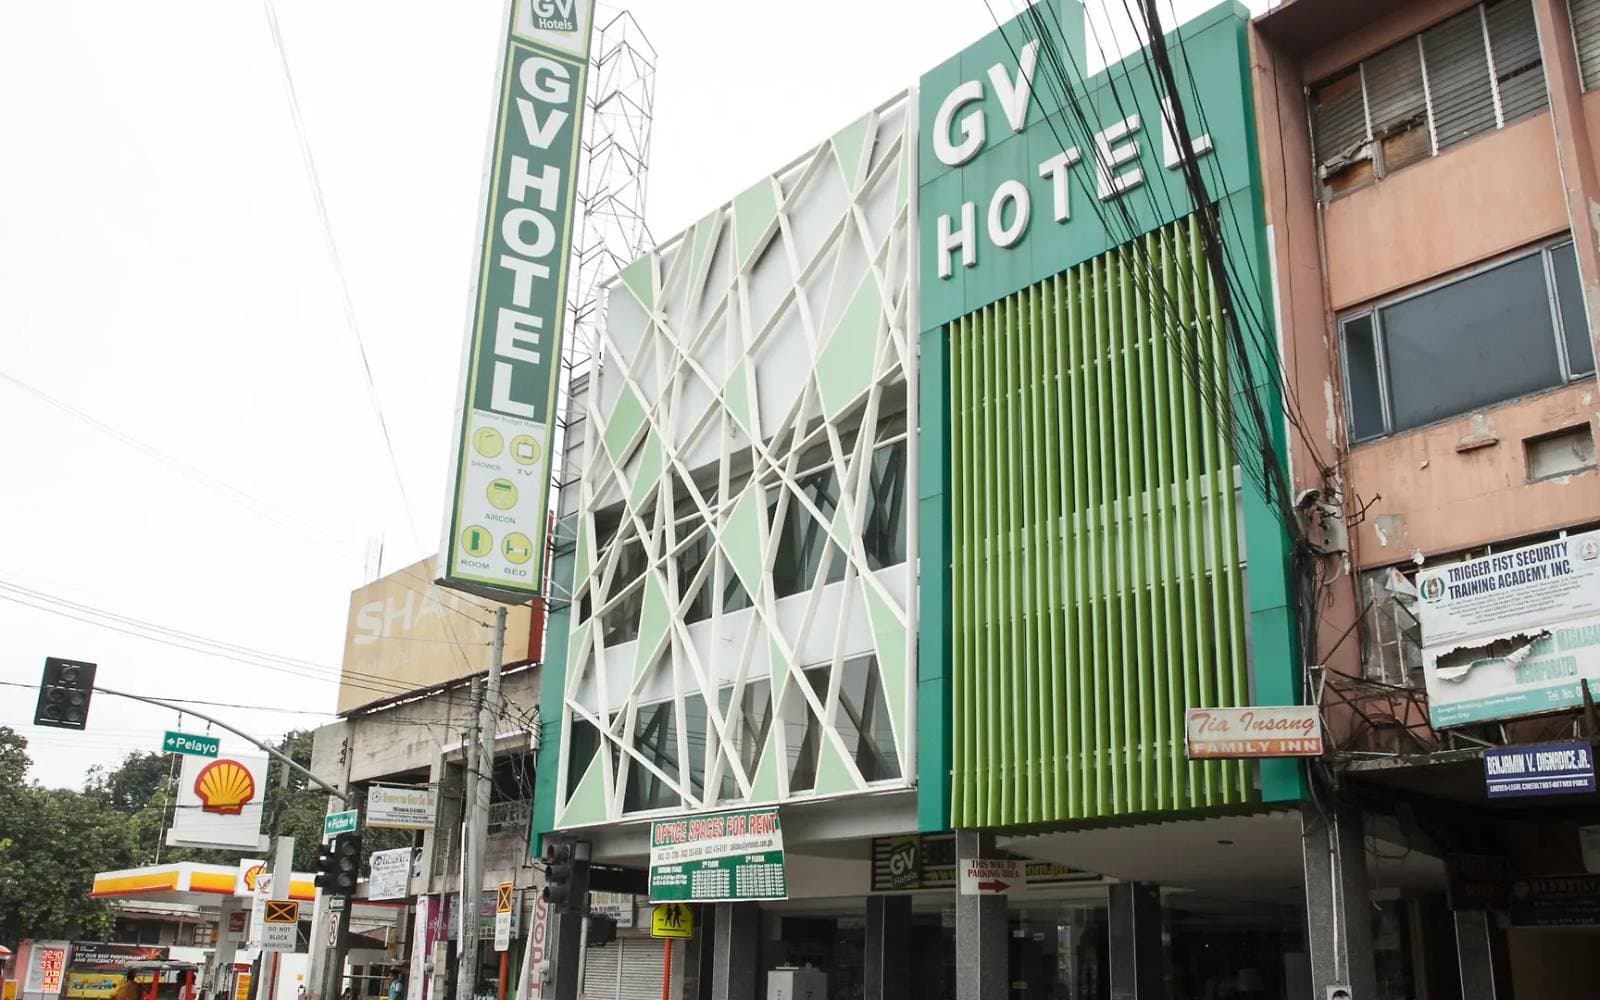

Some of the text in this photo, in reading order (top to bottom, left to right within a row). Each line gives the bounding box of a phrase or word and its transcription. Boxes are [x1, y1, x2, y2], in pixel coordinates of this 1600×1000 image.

[532, 0, 574, 18] GV
[539, 18, 573, 30] Hotels
[932, 38, 1041, 168] GV
[936, 96, 1214, 280] HOTEL
[471, 460, 533, 477] SHOWER TV
[484, 512, 517, 525] AIRCON
[461, 559, 527, 577] ROOM BED
[1448, 541, 1568, 583] TRIGGER FIST SECURITY
[1448, 560, 1574, 600] TRAINING ACADEMY, INC.
[1191, 711, 1316, 736] Tia Insang
[176, 738, 217, 754] Pelayo
[1195, 740, 1317, 753] FAMILY INN
[1487, 754, 1525, 775] BENJAMIN
[655, 813, 776, 845] OFFICE SPACES FOR RENT
[889, 847, 916, 875] GV
[971, 860, 989, 869] THIS
[1007, 861, 1017, 870] TO
[893, 871, 918, 888] Hotels
[967, 868, 1001, 878] PARKING
